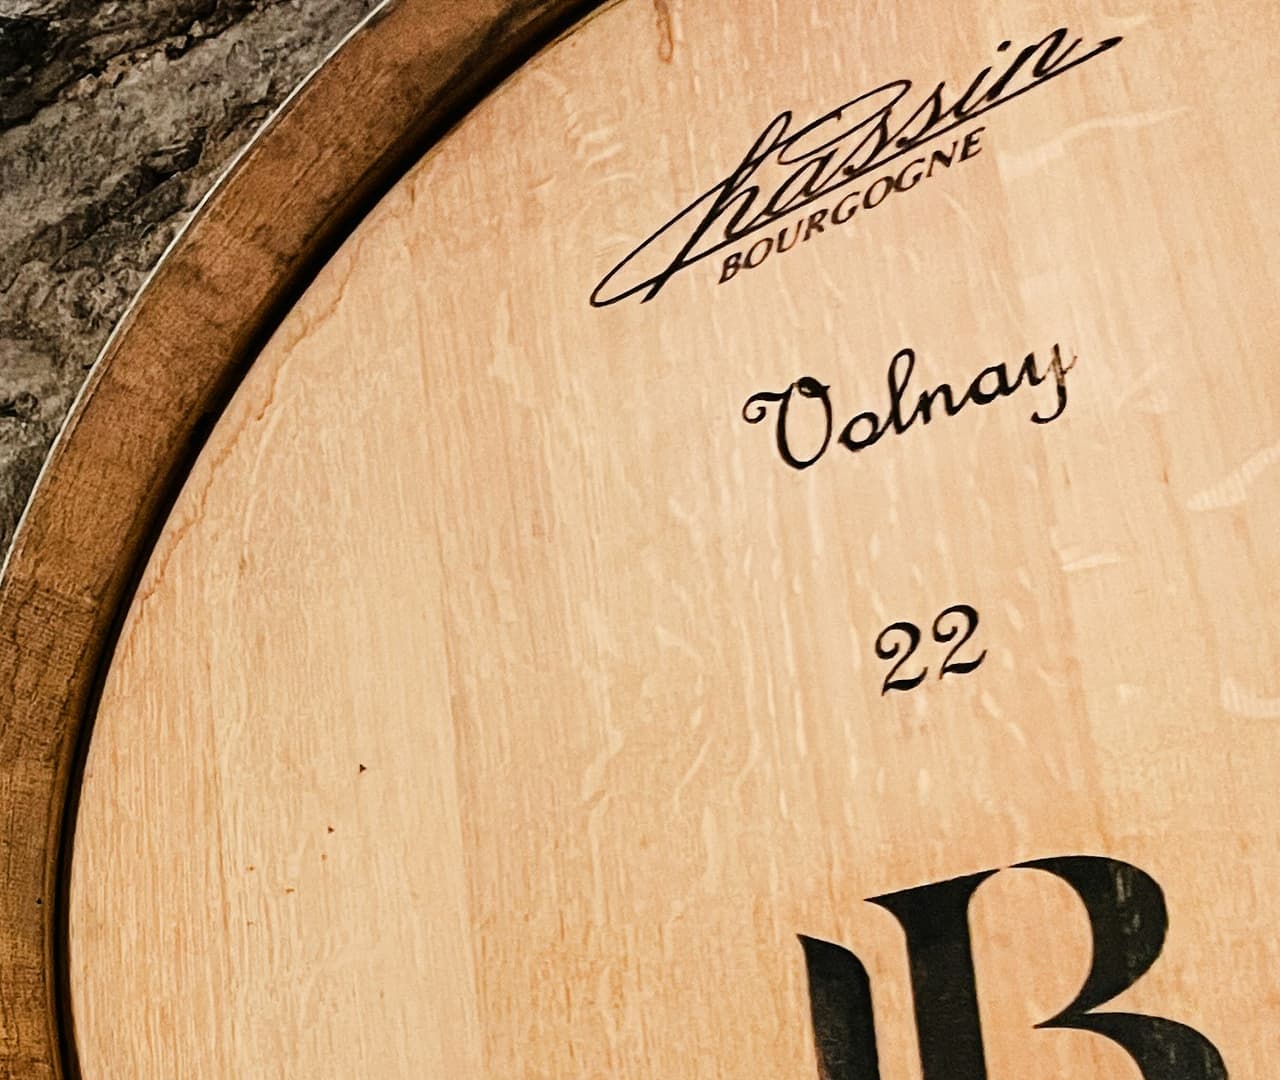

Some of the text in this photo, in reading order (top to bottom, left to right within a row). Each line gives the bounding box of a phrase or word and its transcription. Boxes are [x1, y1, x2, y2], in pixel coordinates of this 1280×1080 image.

[718, 126, 986, 284] BOURGOGNE
[742, 342, 1078, 470] Volnay
[875, 604, 987, 696] 22
